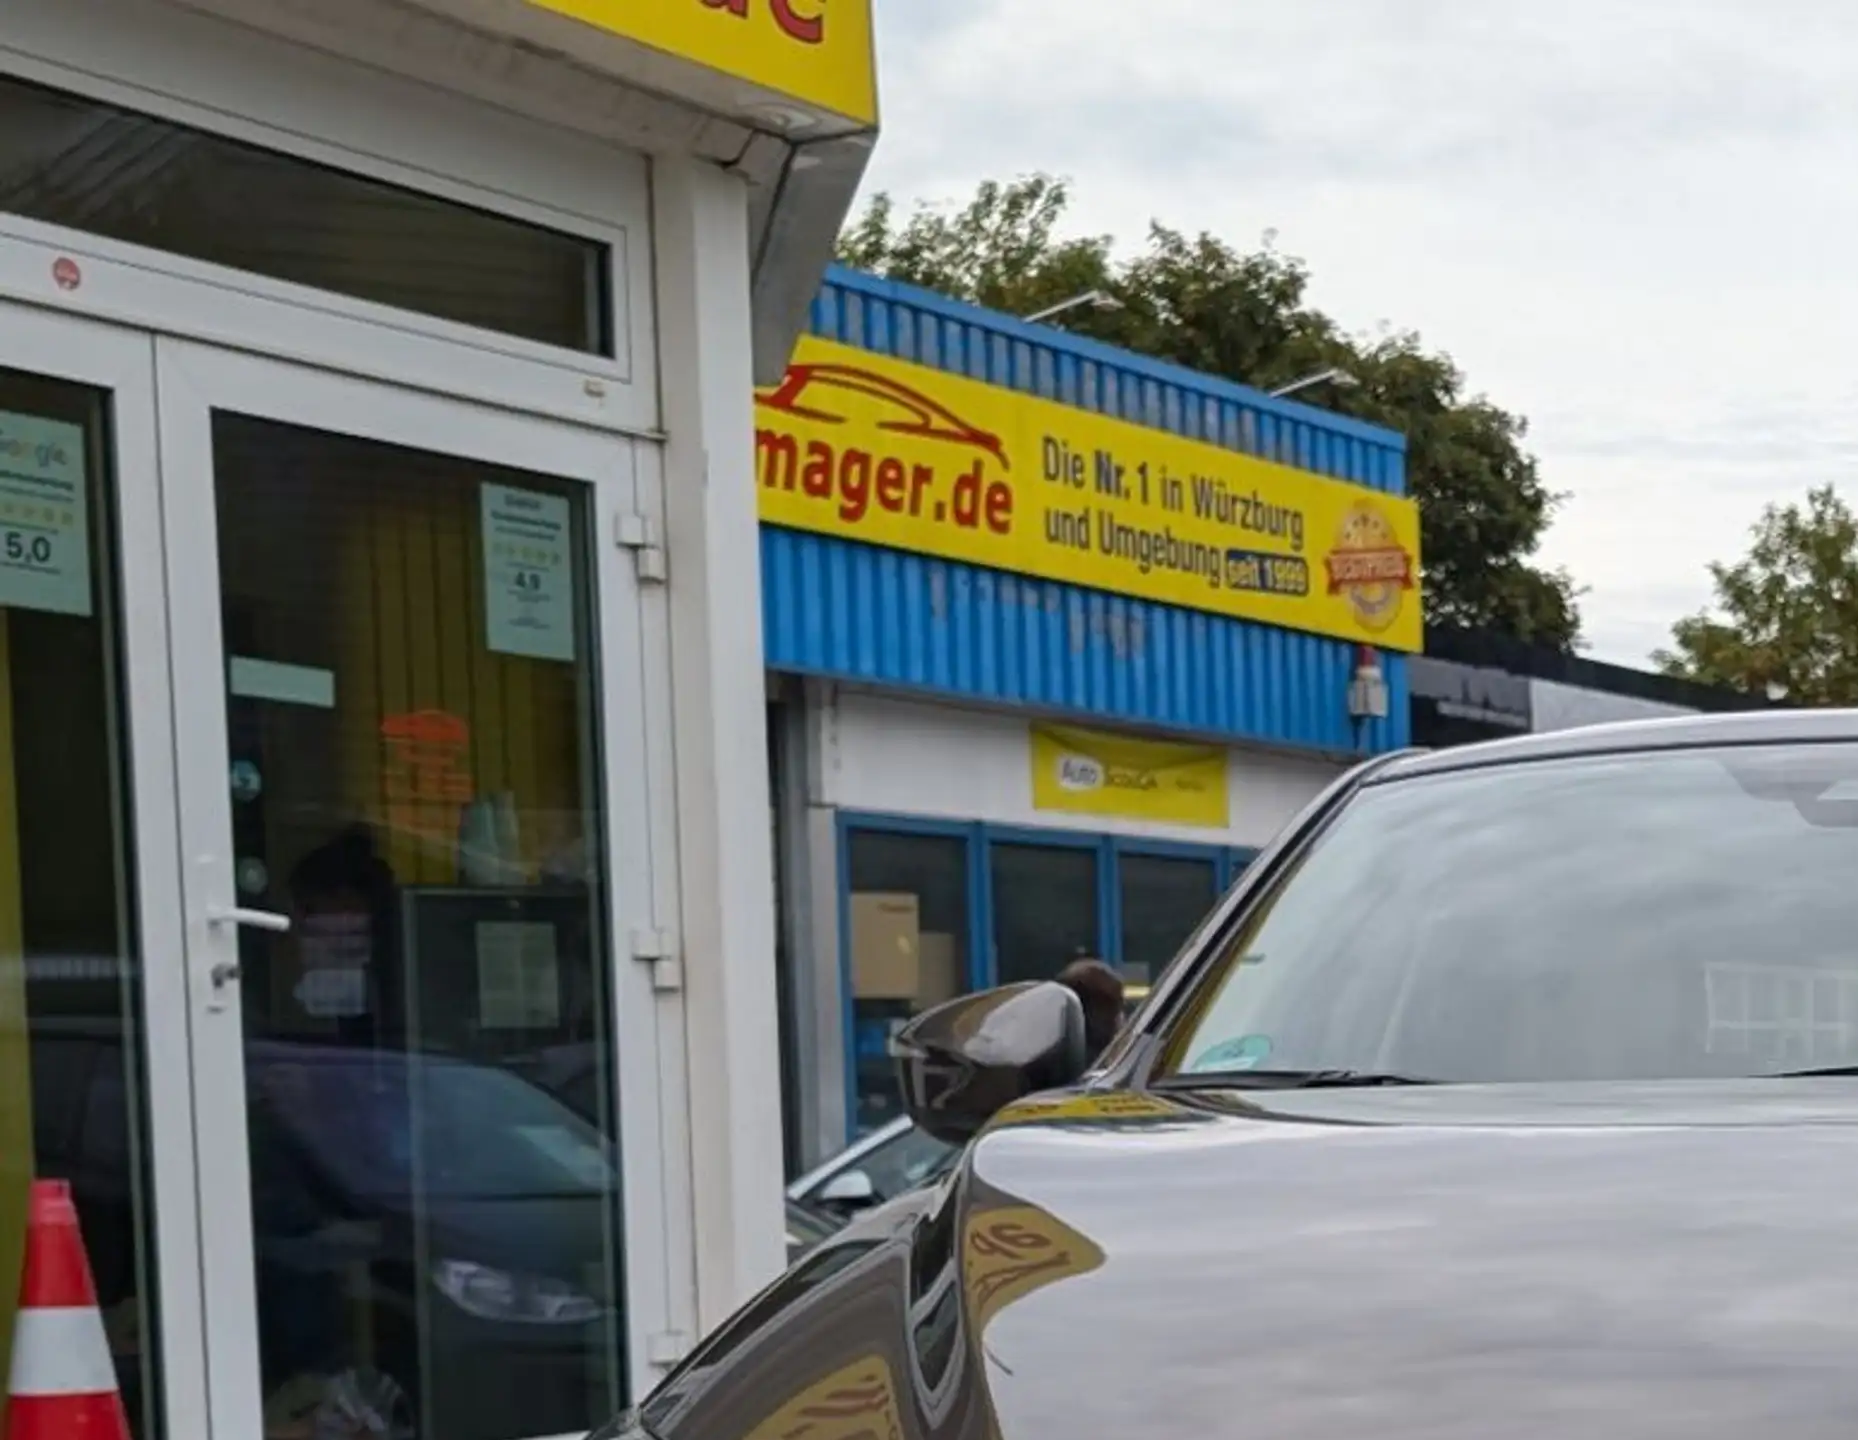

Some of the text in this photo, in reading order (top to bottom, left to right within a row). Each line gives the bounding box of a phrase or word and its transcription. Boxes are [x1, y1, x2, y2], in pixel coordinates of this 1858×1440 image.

[1042, 436, 1305, 552] Die Nr. 1 in Würzburg
[1044, 505, 1091, 550] und
[1097, 508, 1222, 589] Umgebung
